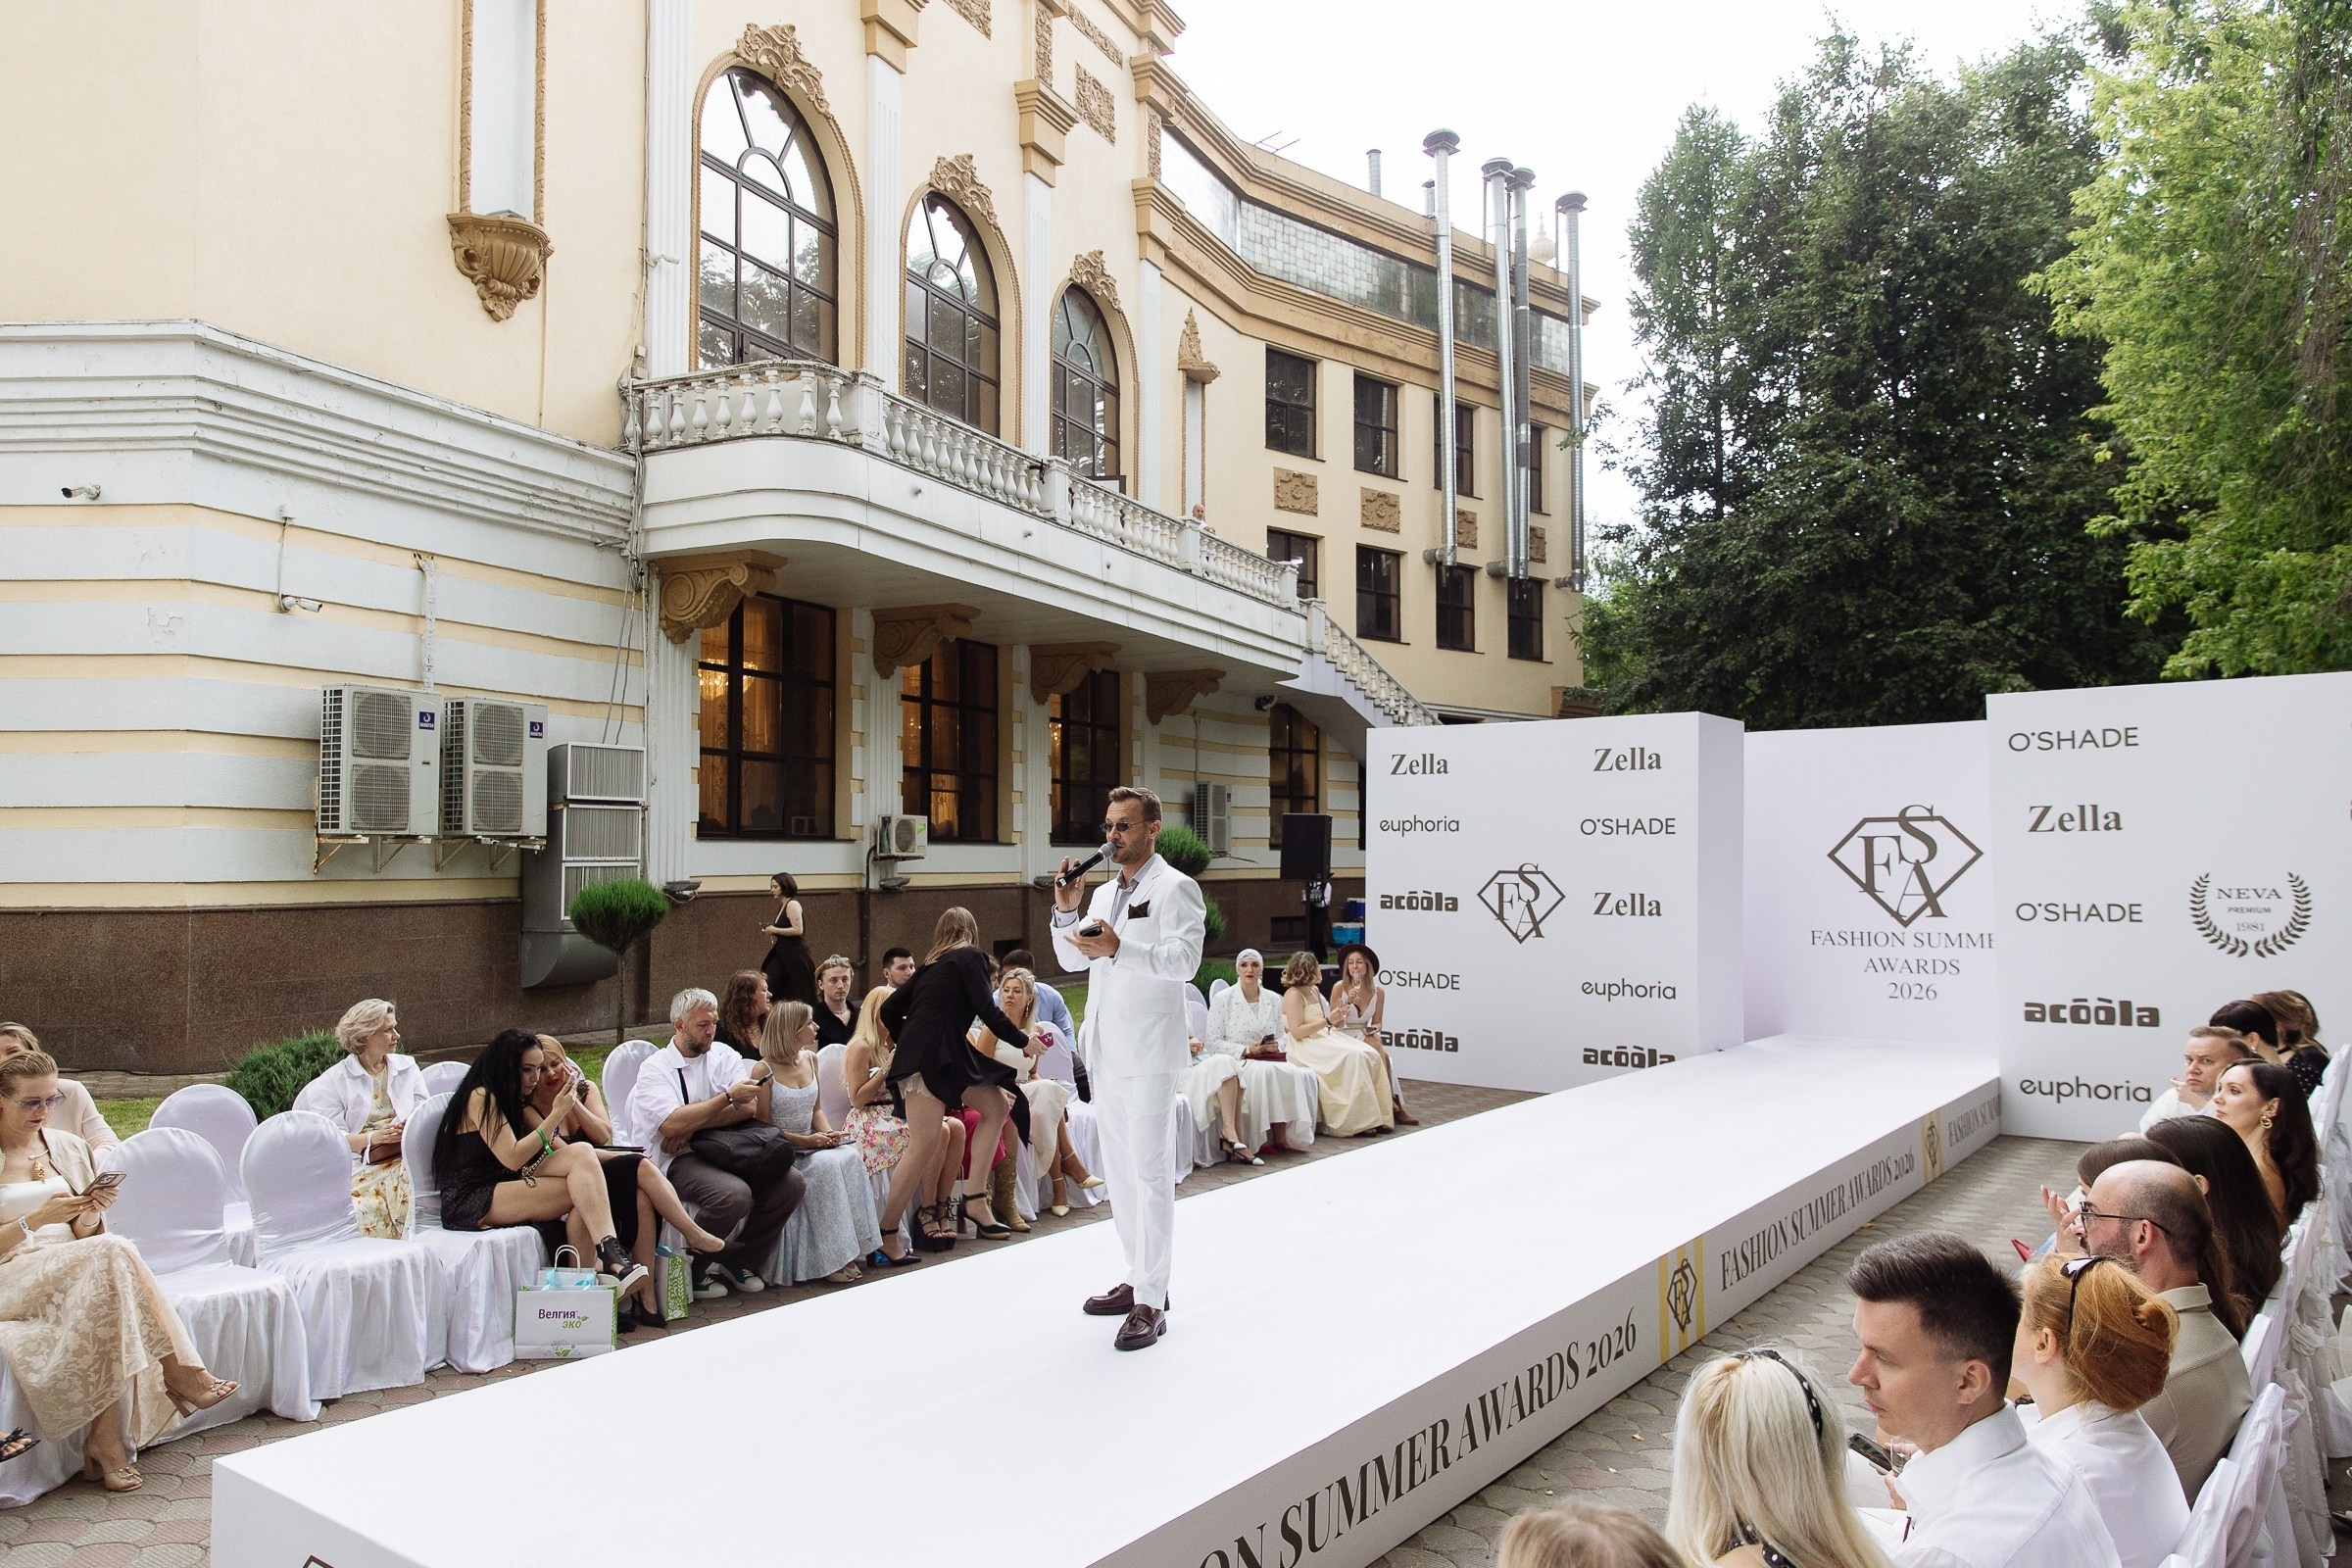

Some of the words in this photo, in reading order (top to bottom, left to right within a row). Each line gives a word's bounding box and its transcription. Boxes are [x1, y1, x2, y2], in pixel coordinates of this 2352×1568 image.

[1390, 753, 1448, 775] Zella
[1593, 747, 1662, 772] Zella
[1379, 814, 1460, 837] euphoria
[2028, 804, 2123, 833] Zella
[1592, 892, 1663, 917] Zella
[2217, 888, 2282, 900] NEVA
[2236, 922, 2265, 932] 1981
[1810, 930, 1906, 948] FASHION
[1913, 931, 1995, 950] SUMME
[1864, 957, 1961, 976] AWARDS
[1581, 977, 1677, 1002] euphoria
[1887, 981, 1937, 1001] 2026
[2019, 1075, 2152, 1103] euphoria
[1721, 1217, 1788, 1292] FASHION
[1791, 1183, 1846, 1246] SUMMER
[1846, 1155, 1892, 1210] AWARDS
[1893, 1145, 1915, 1180] 2026
[538, 1308, 576, 1319] Велгия
[1280, 1418, 1451, 1568] SUMMER
[1456, 1340, 1580, 1461] AWARDS
[1586, 1306, 1637, 1378] 2026
